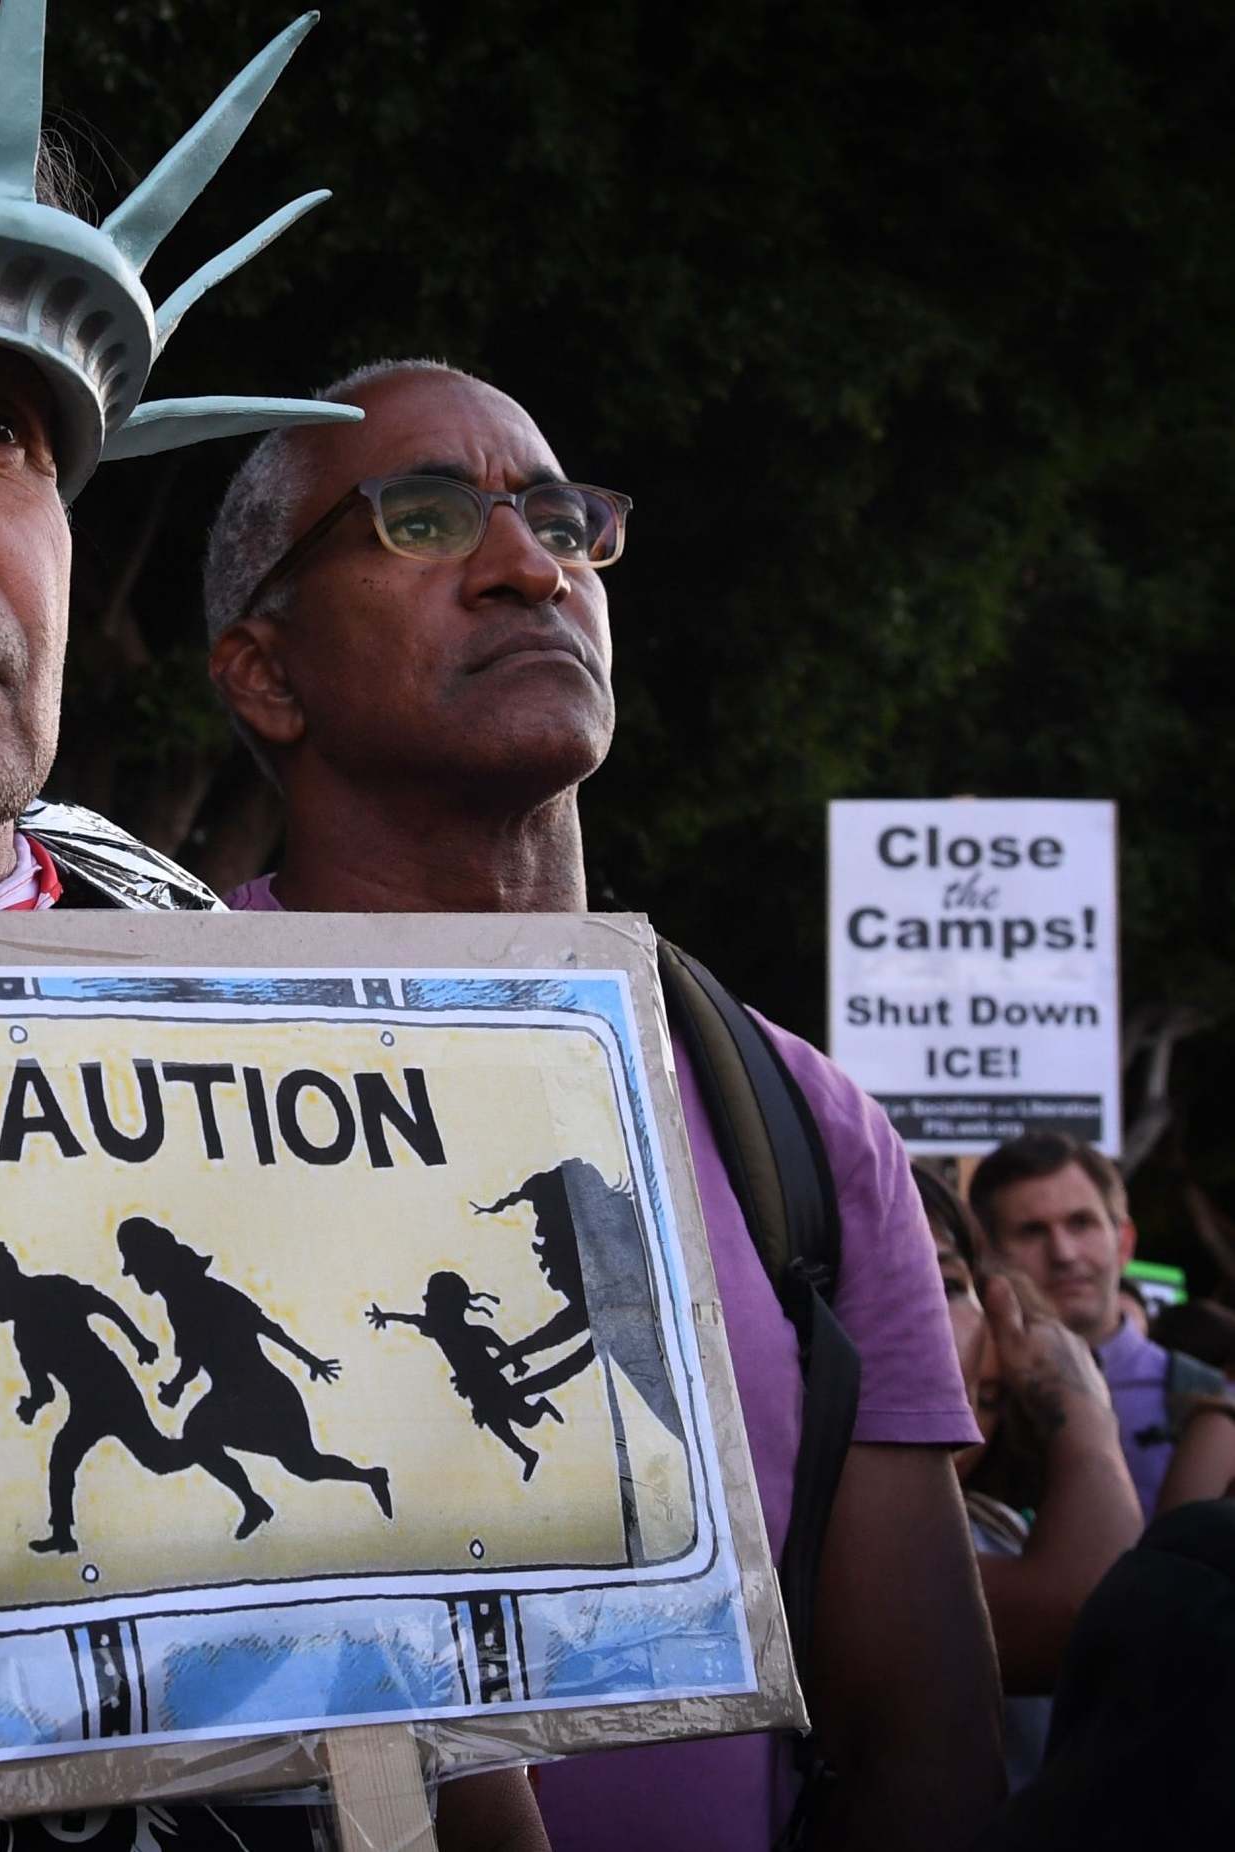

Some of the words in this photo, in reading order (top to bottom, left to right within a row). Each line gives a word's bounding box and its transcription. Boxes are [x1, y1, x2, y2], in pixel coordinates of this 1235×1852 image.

[877, 826, 1064, 869] Close
[941, 870, 1000, 911] the
[846, 905, 1096, 959] Camps!
[846, 995, 952, 1027] Shut
[970, 995, 1101, 1027] Down
[925, 1047, 1021, 1079] ICE!
